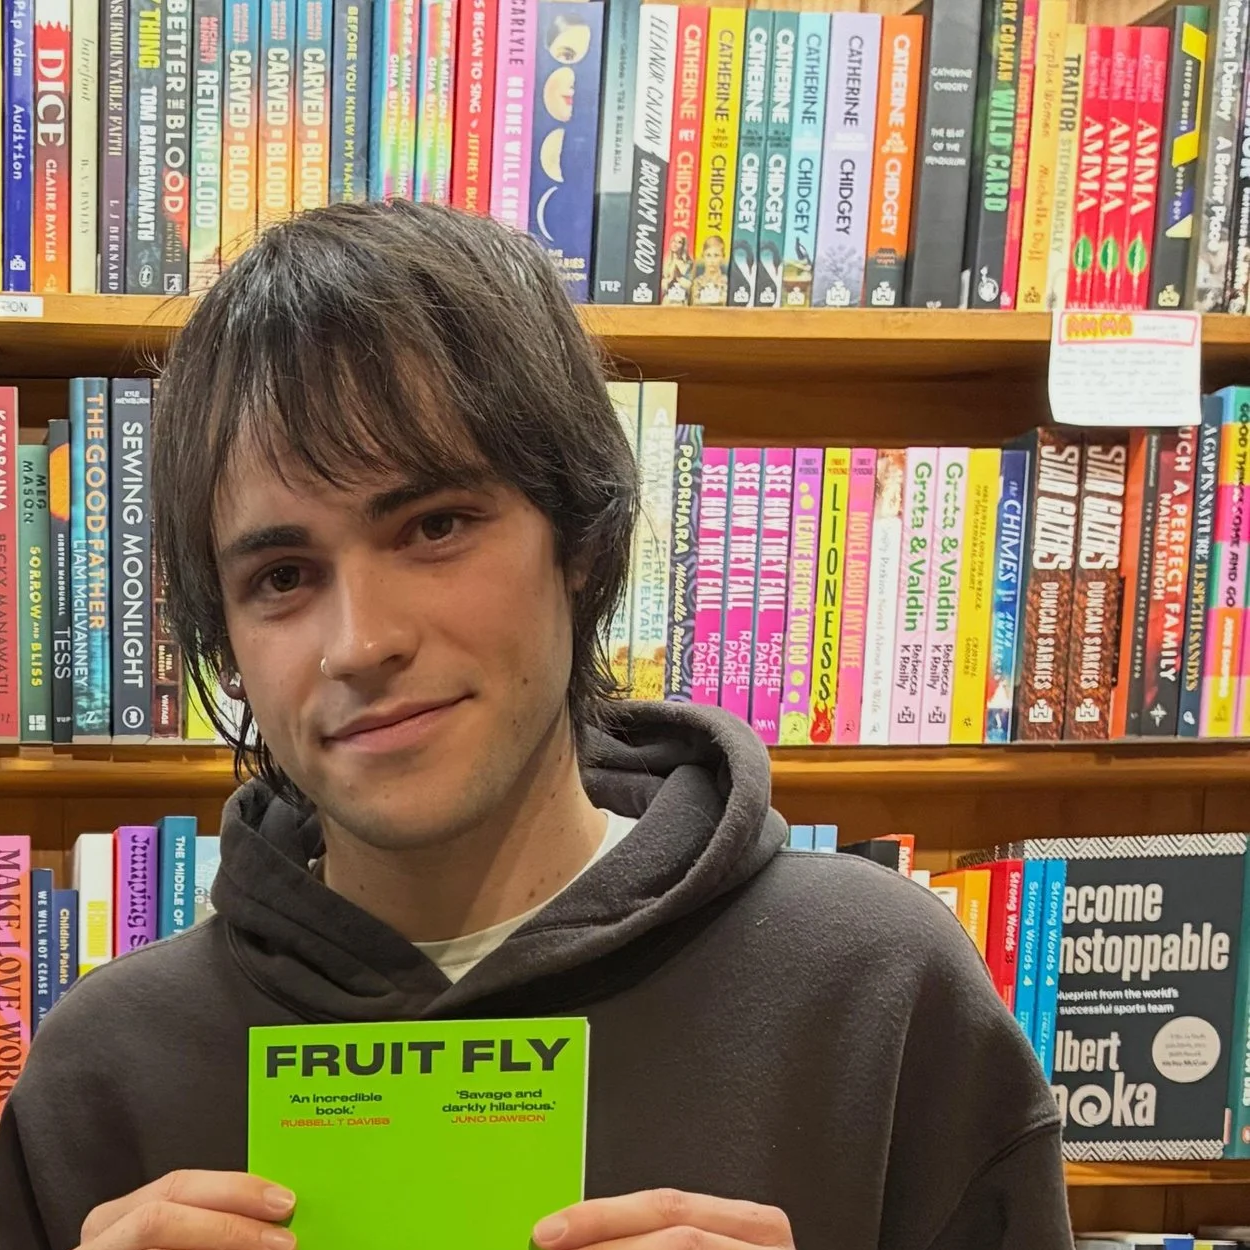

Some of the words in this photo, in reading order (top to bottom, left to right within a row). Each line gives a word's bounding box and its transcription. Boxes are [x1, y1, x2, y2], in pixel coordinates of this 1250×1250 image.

[37, 48, 65, 148] DICE
[229, 50, 251, 129] CARVED
[679, 24, 702, 120] CATHERINE
[801, 33, 822, 125] CATHERINE
[843, 35, 864, 126] CATHERINE
[1059, 54, 1081, 133] TRAITOR
[13, 104, 22, 180] Audition
[228, 145, 250, 211] BLOOD
[1077, 117, 1103, 213] AMMA
[1101, 117, 1130, 213] AMMA
[1130, 119, 1158, 215] AMMA
[673, 152, 695, 230] CHIDGEY
[707, 155, 727, 233] CHIDGEY
[794, 157, 814, 234] CHIDGEY
[836, 159, 855, 236] CHIDGEY
[122, 421, 143, 525] SEWING
[122, 533, 144, 688] MOONLIGHT
[818, 483, 840, 701] LIONESS
[904, 559, 926, 632] Valdin
[30, 642, 42, 687] BLISS
[54, 627, 71, 680] TESS
[1160, 602, 1181, 682] FAMILY
[1063, 882, 1163, 924] ecome
[1059, 922, 1230, 982] nstoppable
[266, 1041, 445, 1079] FRUIT
[462, 1038, 571, 1073] FLY
[1055, 1030, 1120, 1073] lbert
[281, 1118, 334, 1127] RUSSELL
[337, 1118, 345, 1126] T
[313, 1093, 382, 1103] incredible
[442, 1103, 486, 1115] darkly
[451, 1115, 486, 1124] JUNO
[489, 1114, 546, 1123] DAWSON
[515, 1089, 542, 1098] and
